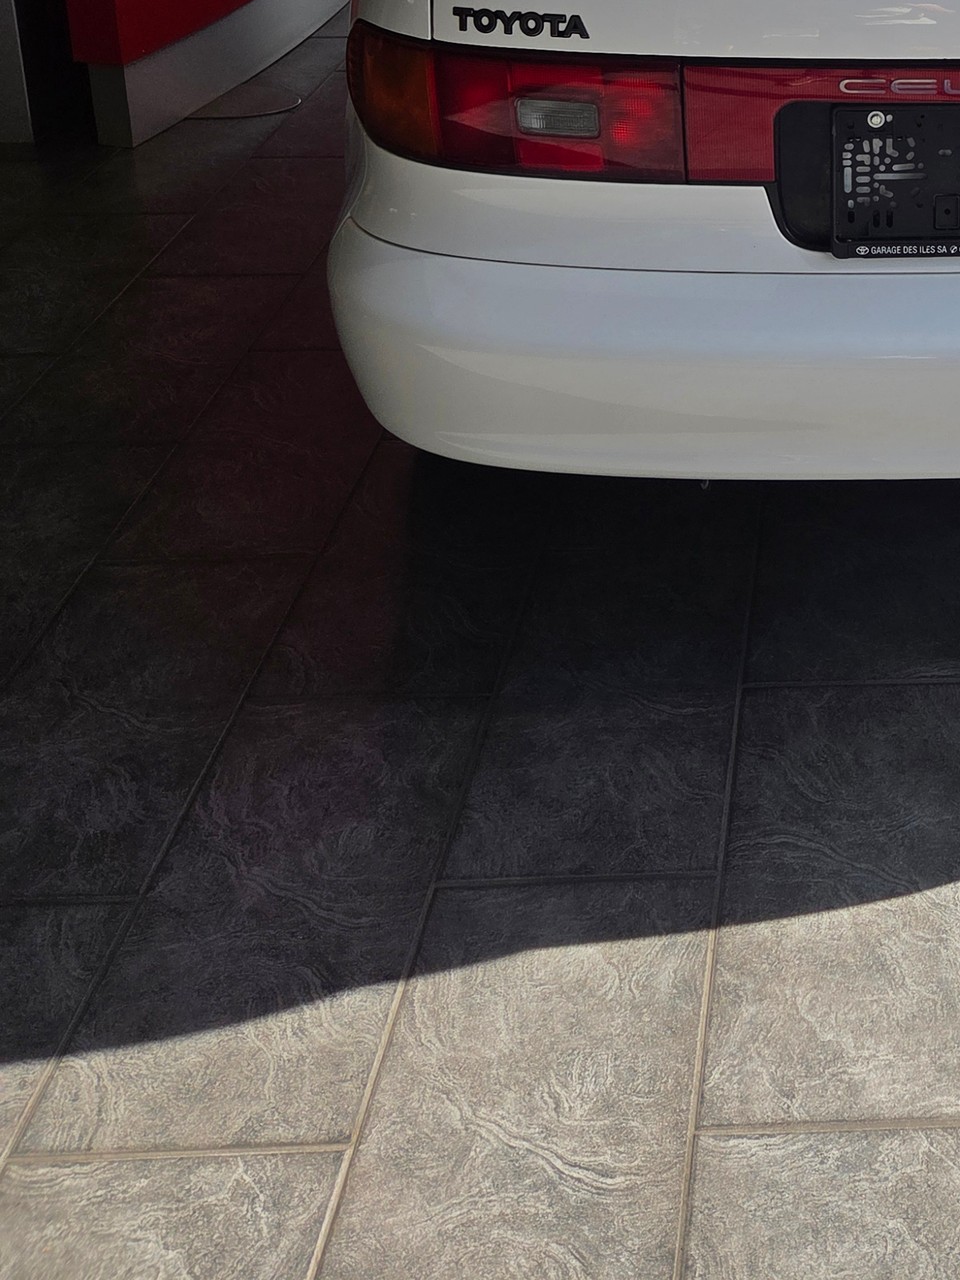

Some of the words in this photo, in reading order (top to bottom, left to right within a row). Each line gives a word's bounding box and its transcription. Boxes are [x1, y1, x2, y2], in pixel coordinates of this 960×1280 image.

[452, 6, 590, 39] TOYOTA
[870, 245, 901, 255] GARAGE
[902, 245, 918, 255] DES
[919, 245, 936, 254] ILES
[936, 245, 948, 254] SA
